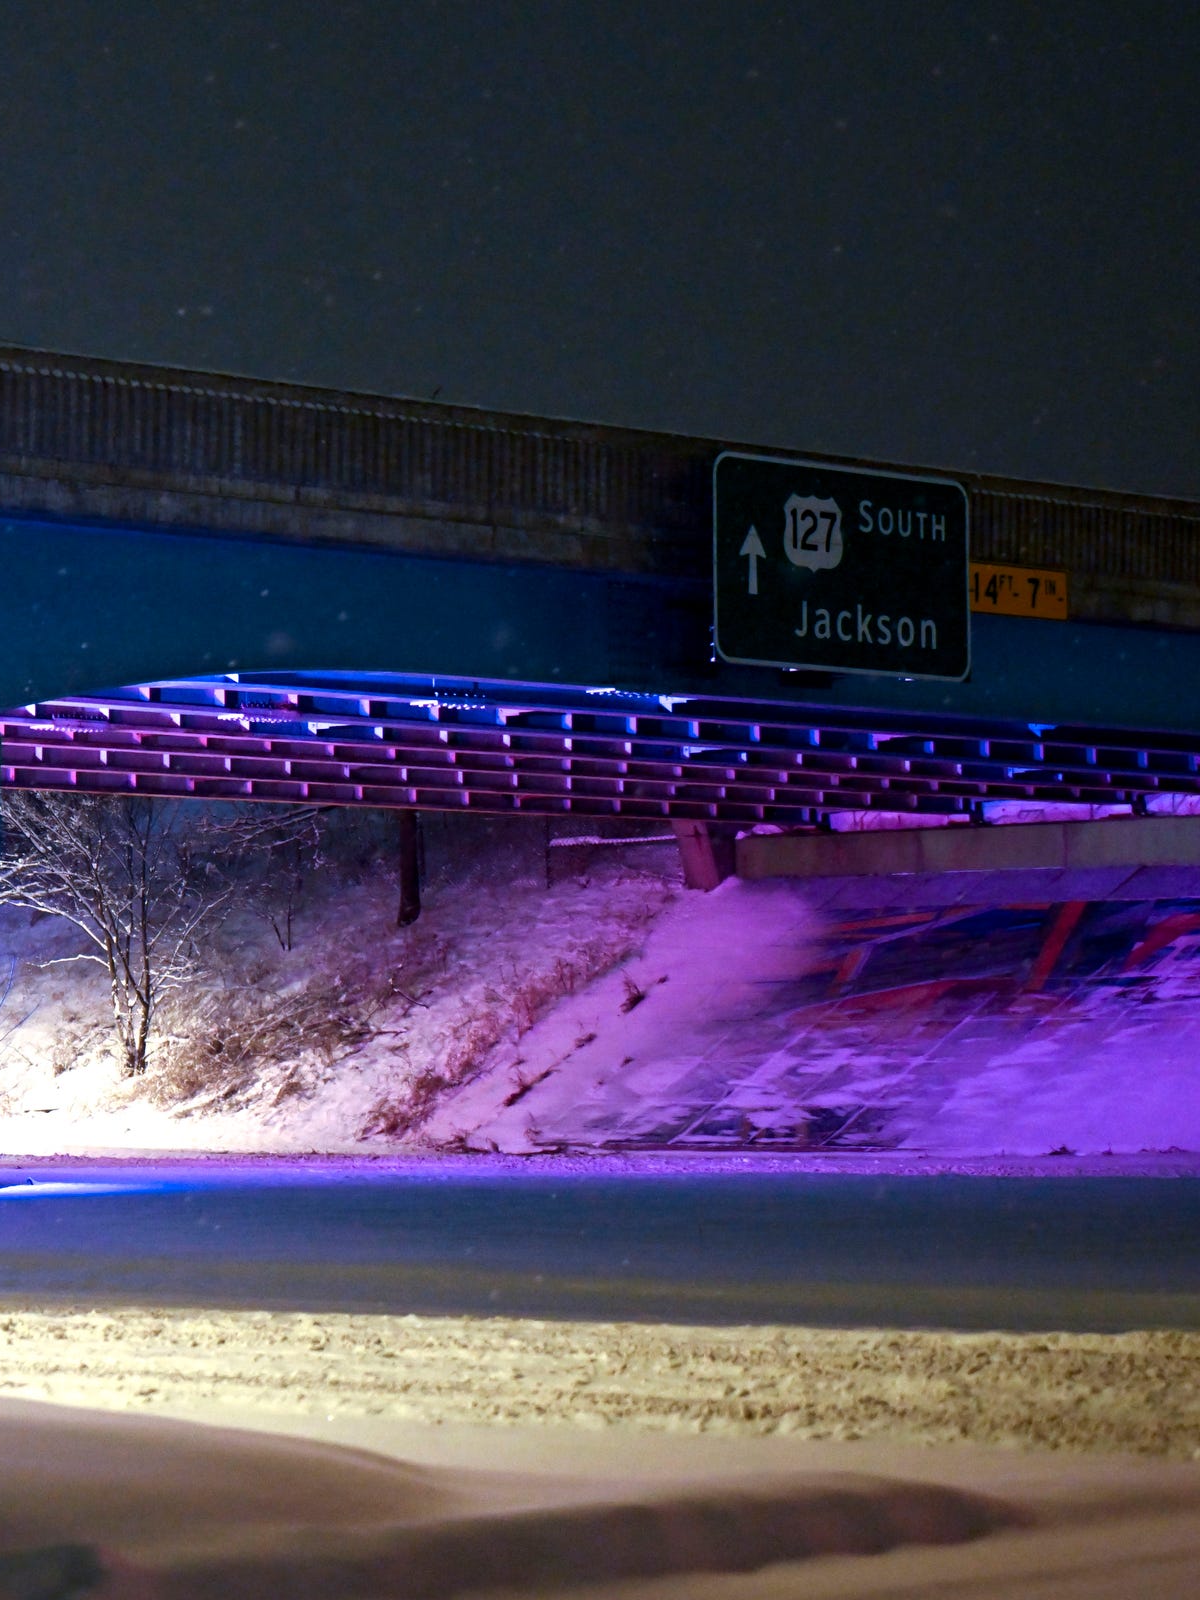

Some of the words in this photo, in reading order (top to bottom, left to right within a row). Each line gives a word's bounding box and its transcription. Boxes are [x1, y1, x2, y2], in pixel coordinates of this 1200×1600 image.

[789, 507, 837, 553] 127
[858, 500, 946, 542] SOUTH
[794, 600, 938, 650] Jackson
